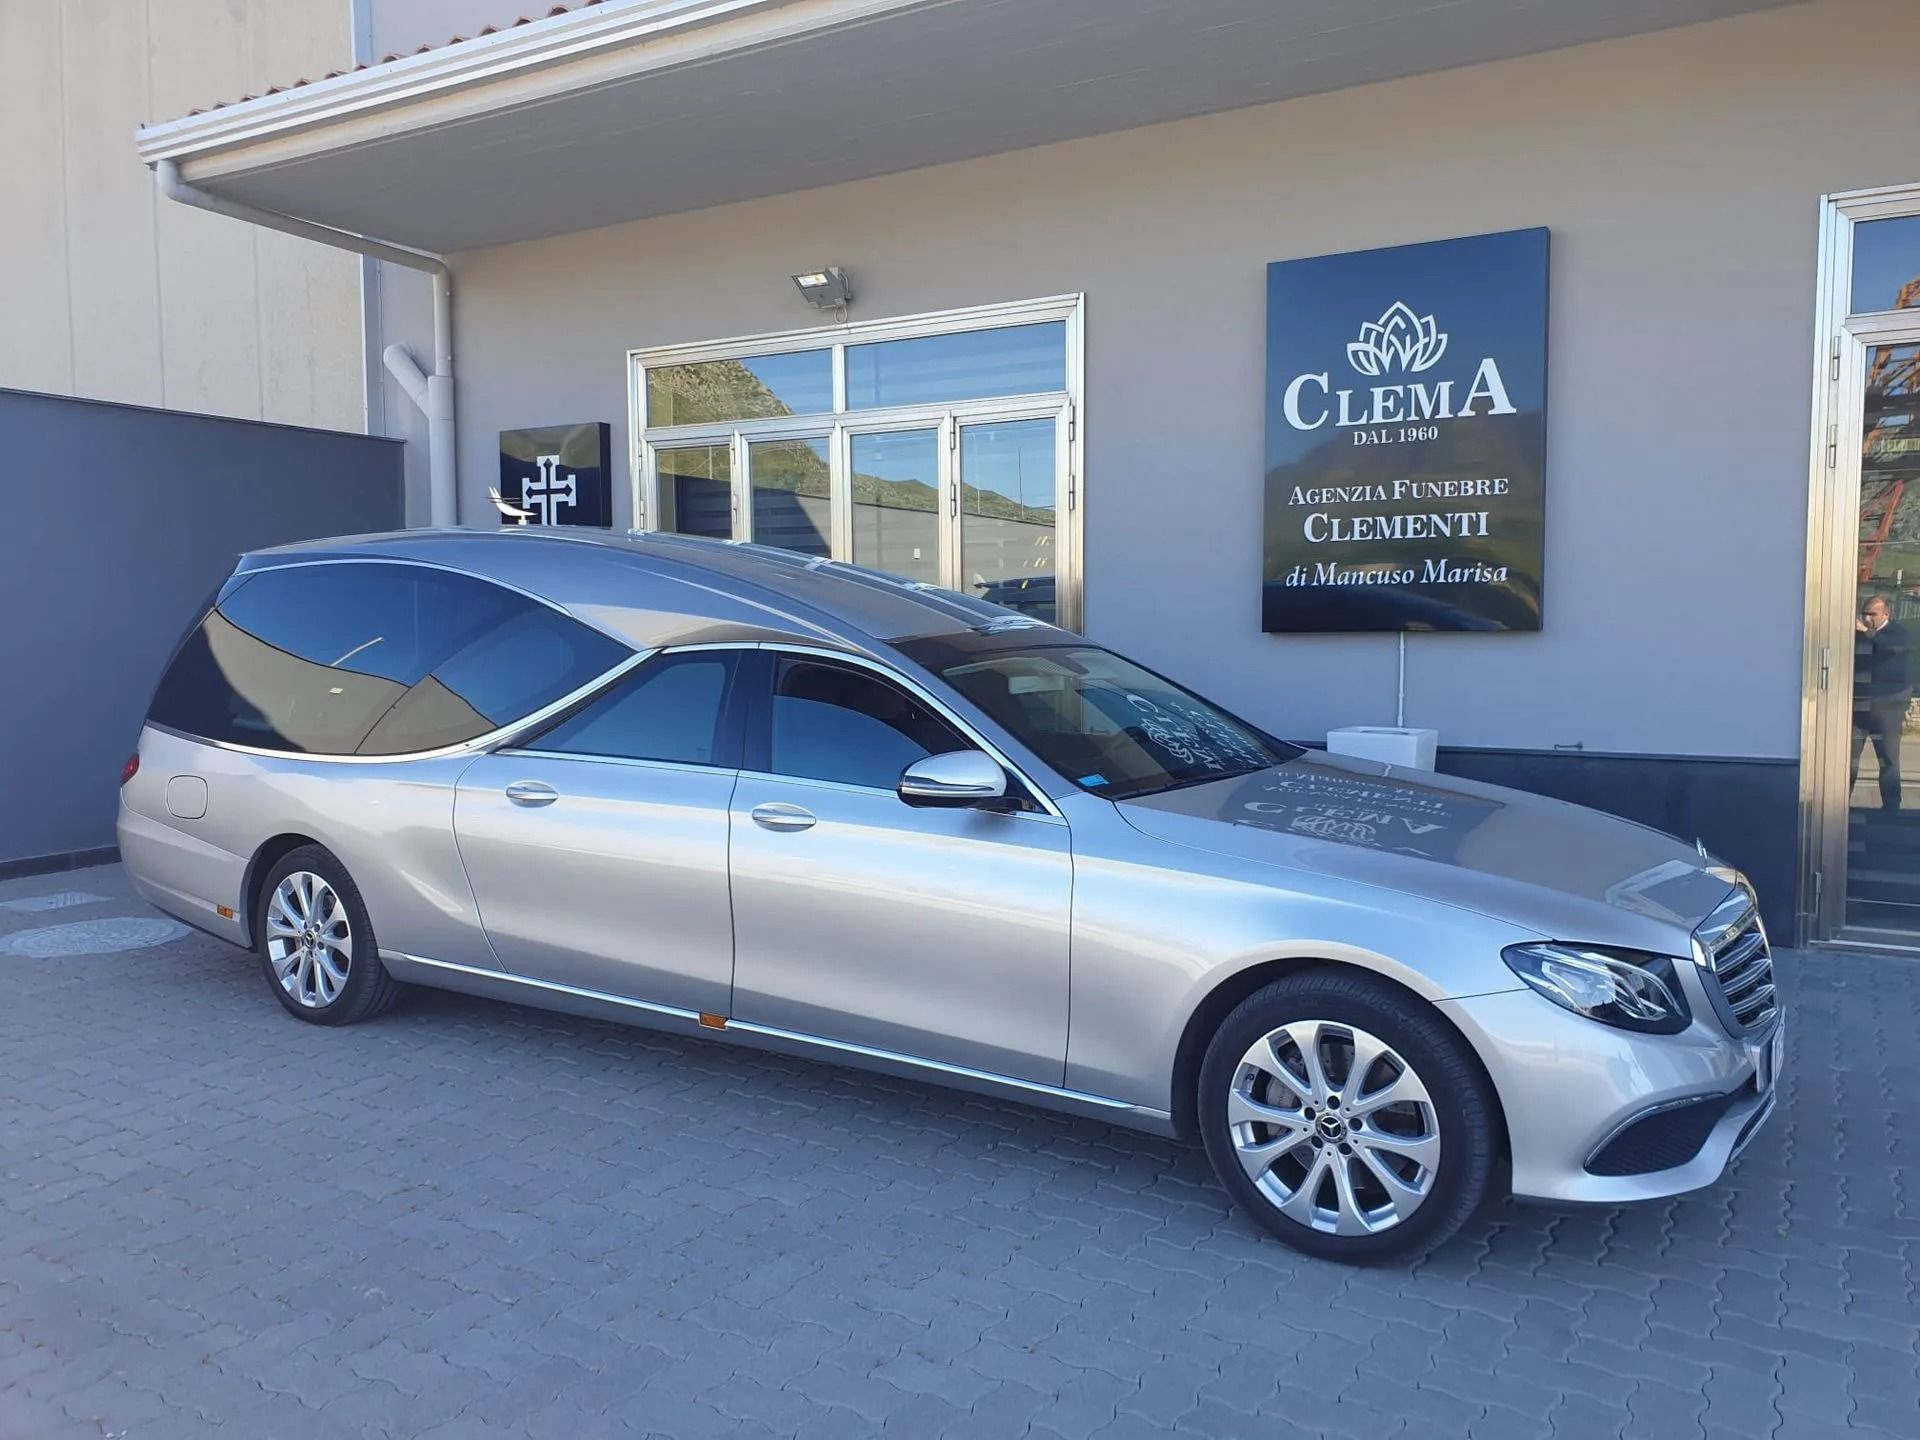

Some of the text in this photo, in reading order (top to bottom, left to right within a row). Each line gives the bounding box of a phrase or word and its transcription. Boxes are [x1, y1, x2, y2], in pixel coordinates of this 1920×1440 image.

[1283, 357, 1517, 431] CLEMA
[1353, 425, 1439, 446] DAL 1960
[1288, 478, 1509, 506] AGENZIA FUNEBRE
[1303, 511, 1490, 543] CLEMENTI
[1286, 558, 1508, 588] di Mancuso Marisa
